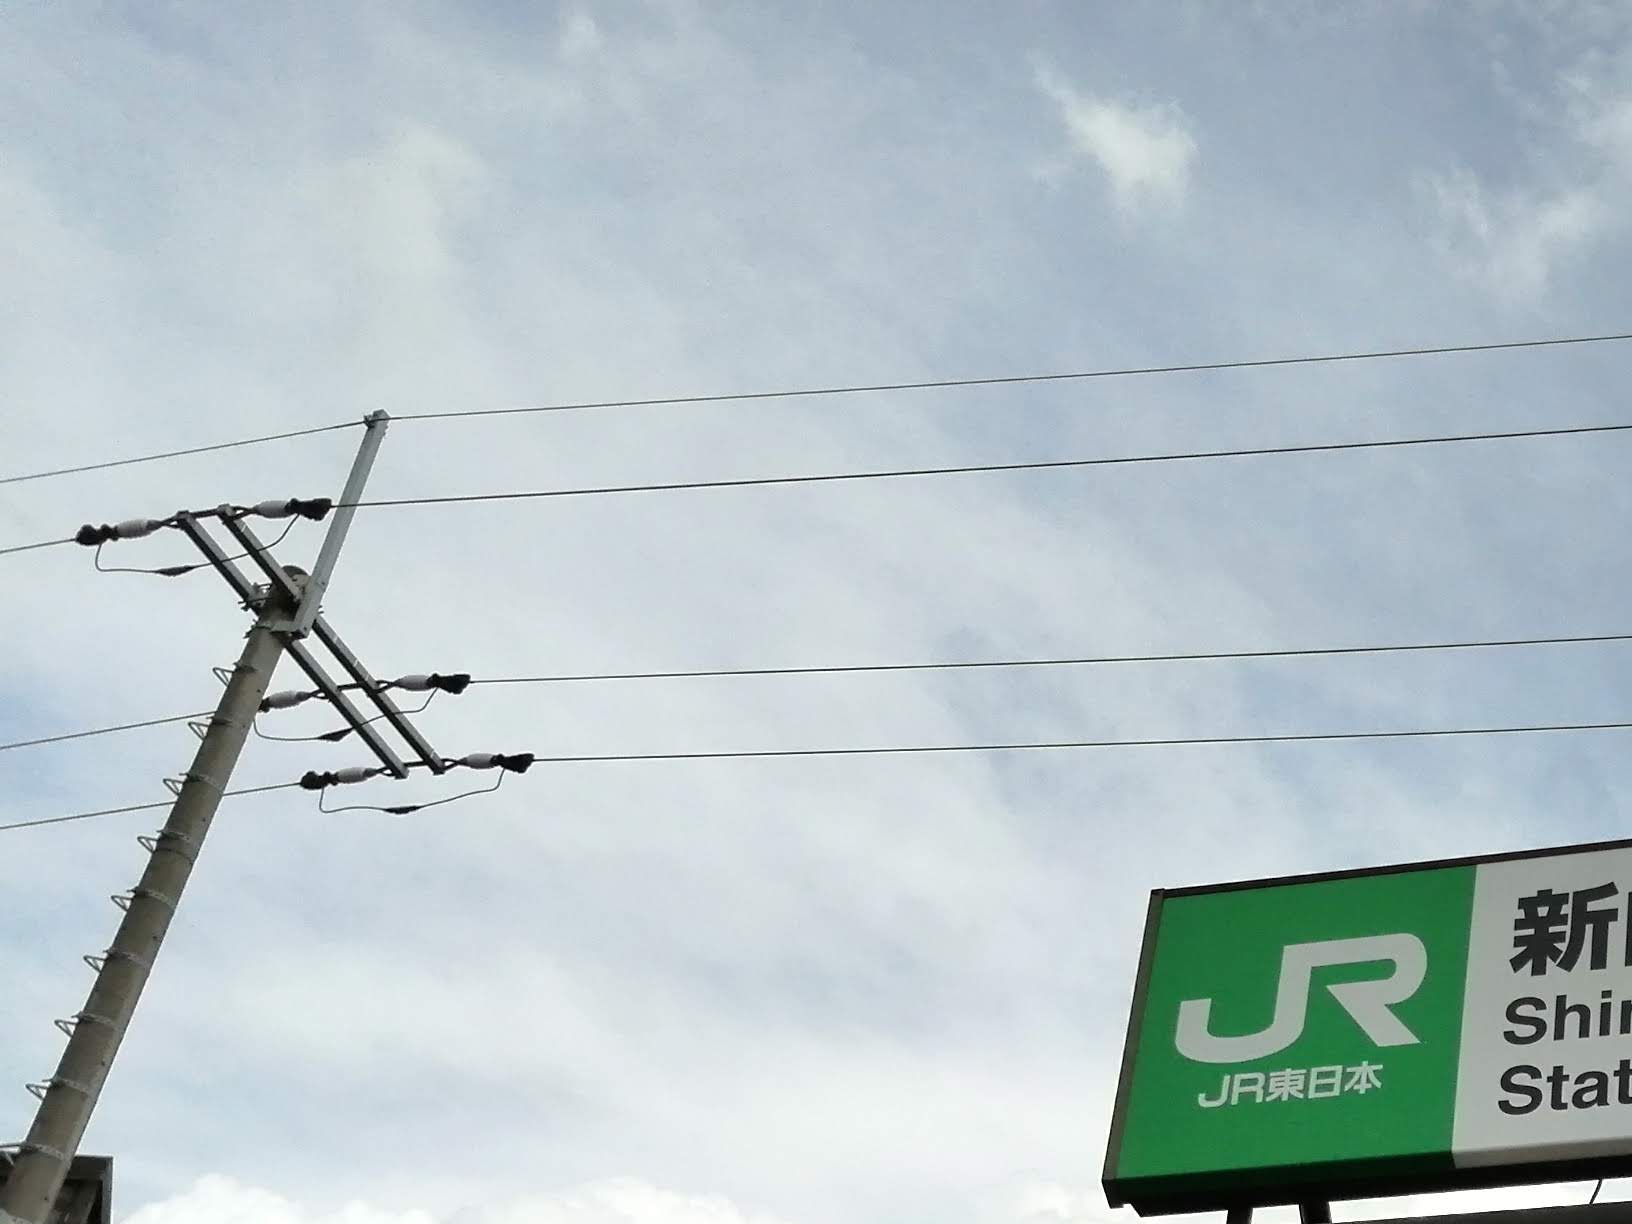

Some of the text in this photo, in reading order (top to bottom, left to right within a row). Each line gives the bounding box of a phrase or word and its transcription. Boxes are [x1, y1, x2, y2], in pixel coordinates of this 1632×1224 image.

[1175, 933, 1427, 1064] JR
[1198, 1060, 1384, 1108] JR東日本
